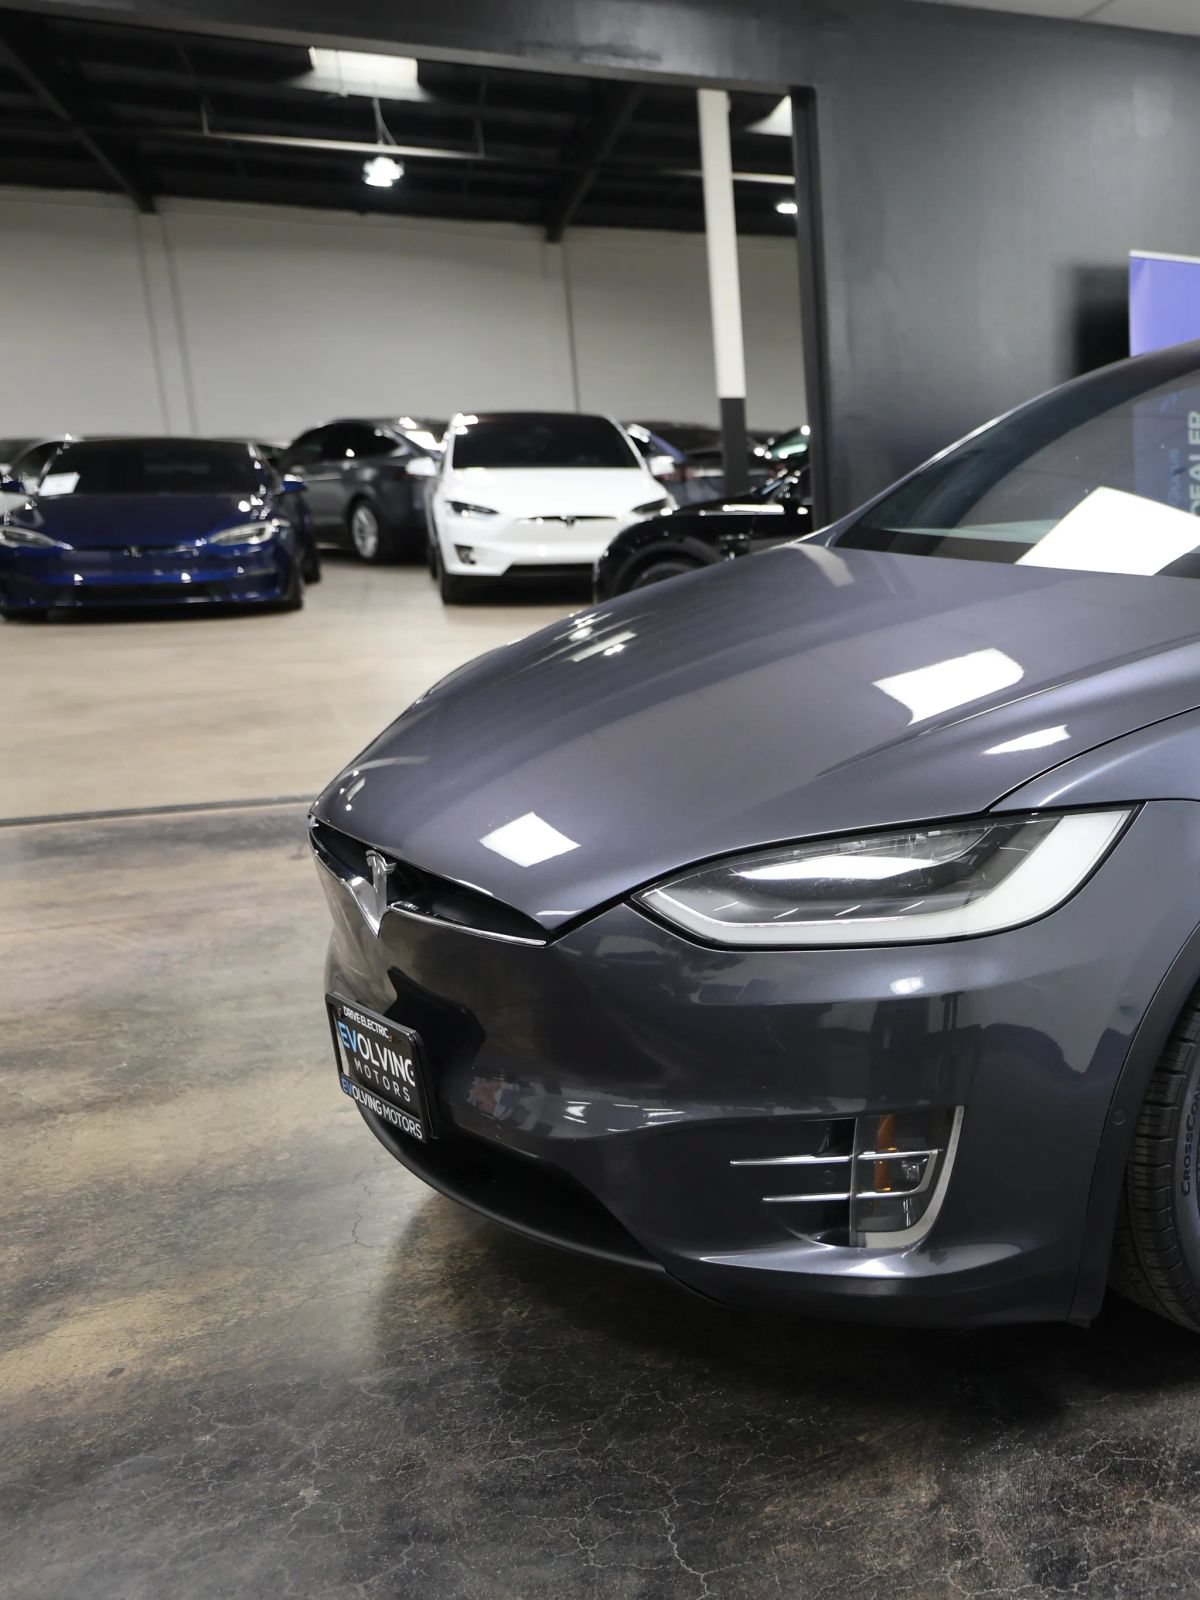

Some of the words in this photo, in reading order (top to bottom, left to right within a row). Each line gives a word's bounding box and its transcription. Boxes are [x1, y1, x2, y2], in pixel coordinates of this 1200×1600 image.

[342, 1005, 361, 1024] DRIVE
[361, 1014, 390, 1039] ELECTRIC
[337, 1020, 416, 1087] EVOLVING
[354, 1057, 411, 1103] MOTORS
[342, 1076, 383, 1116] EVOLVING
[382, 1103, 423, 1140] MOTORS
